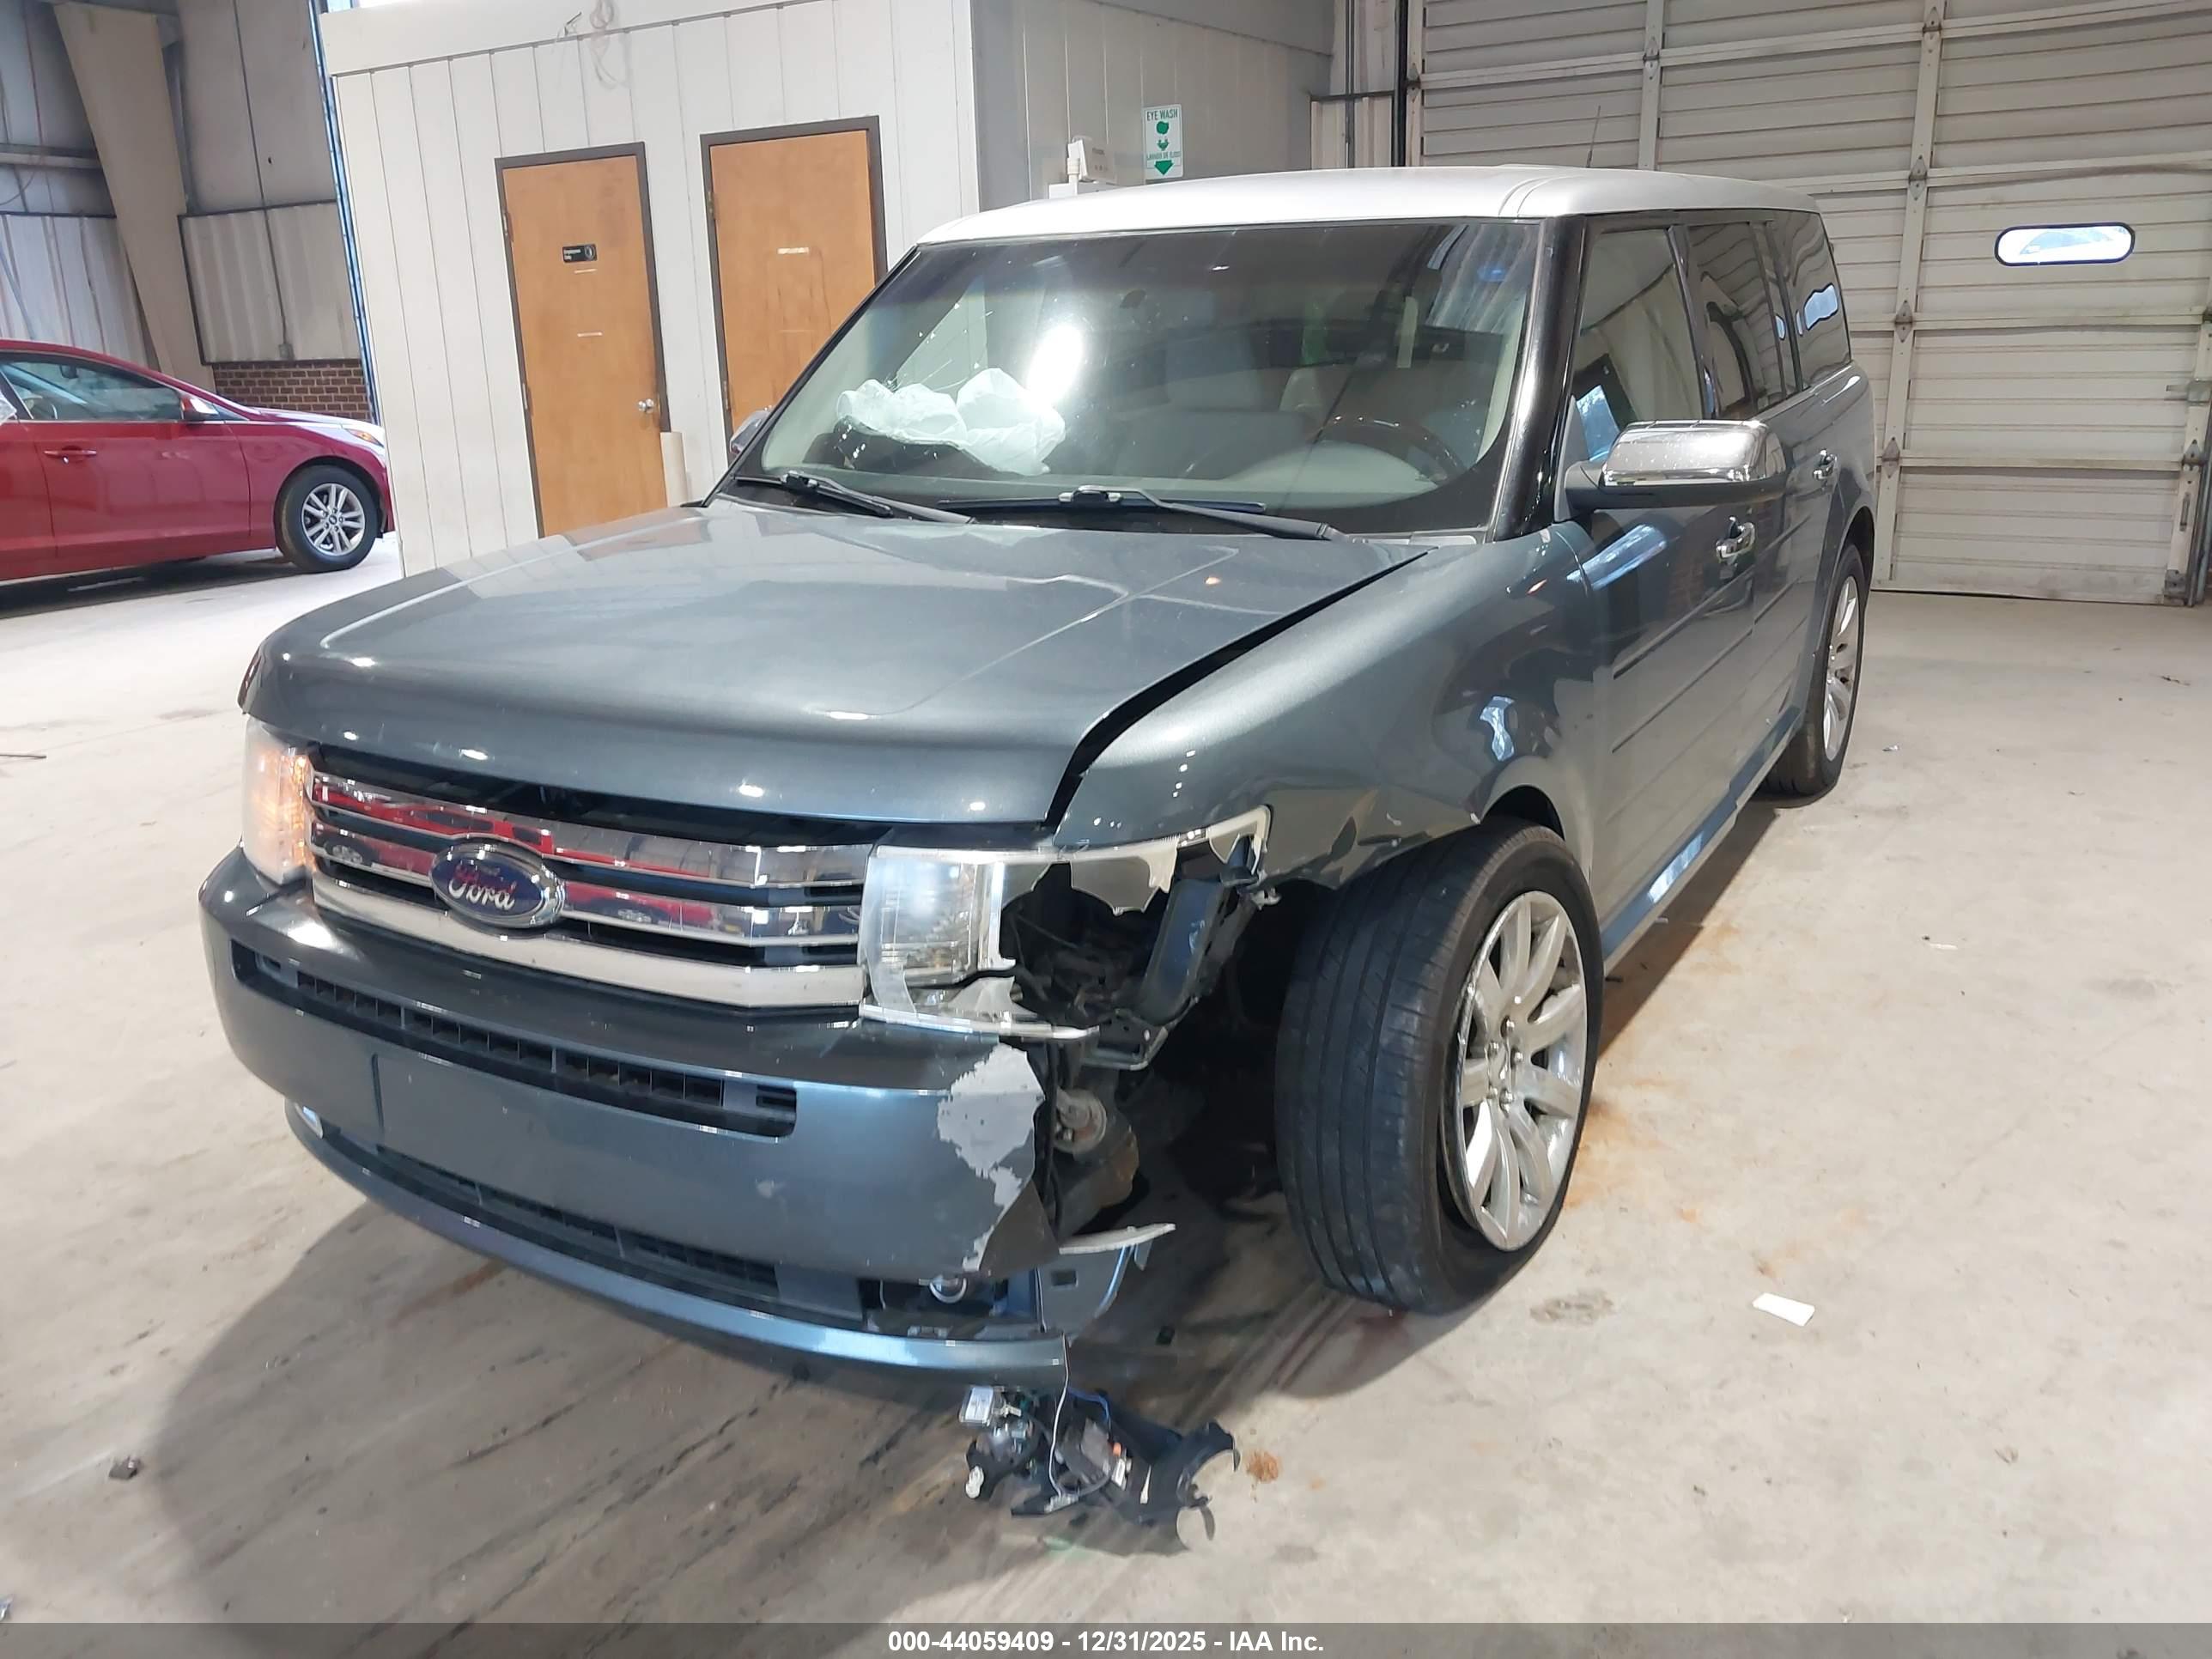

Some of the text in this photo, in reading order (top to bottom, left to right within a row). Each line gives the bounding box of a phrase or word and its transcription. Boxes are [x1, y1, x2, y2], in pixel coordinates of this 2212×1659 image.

[1146, 108, 1178, 121] EYE WASH
[447, 863, 517, 911] Ford
